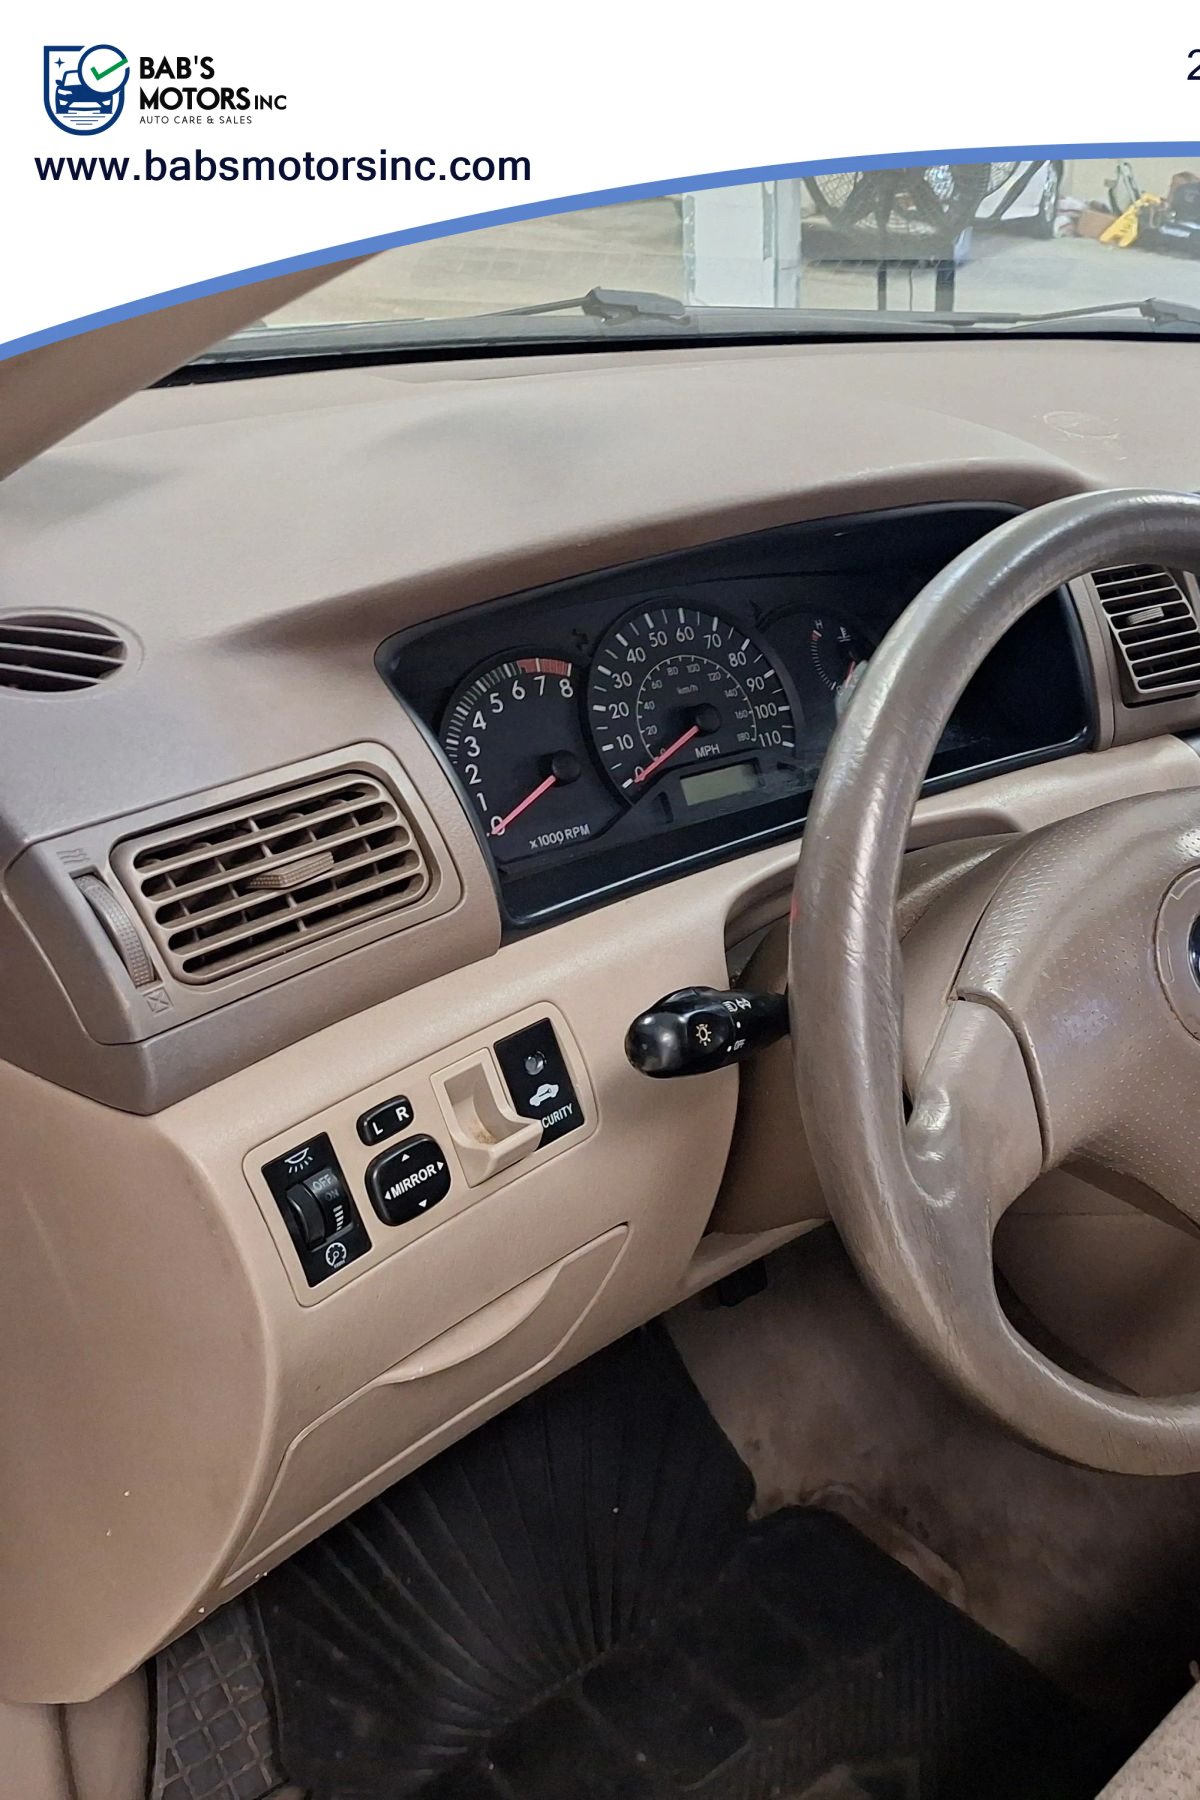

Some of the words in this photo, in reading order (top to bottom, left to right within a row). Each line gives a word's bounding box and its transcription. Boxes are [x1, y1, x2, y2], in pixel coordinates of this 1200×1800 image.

[649, 631, 667, 647] 50
[676, 626, 694, 642] 60
[703, 633, 722, 649] 70
[627, 647, 646, 663] 40
[728, 651, 747, 667] 80
[533, 675, 545, 696] 7
[559, 678, 573, 698] 8
[611, 671, 632, 689] 30
[651, 680, 663, 689] 60
[746, 676, 765, 692] 90
[512, 680, 526, 700] 6
[490, 692, 504, 713] 5
[608, 702, 629, 719] 20
[643, 700, 655, 710] 40
[754, 702, 777, 719] 100
[472, 710, 487, 730] 4
[645, 725, 657, 736] 20
[758, 730, 781, 747] 110
[464, 736, 480, 757] 3
[616, 734, 634, 750] 10
[695, 744, 720, 758] MPH
[465, 764, 482, 784] 2
[477, 793, 488, 811] 1
[490, 816, 506, 836] 0
[395, 1106, 410, 1121] R
[542, 1103, 573, 1128] CURITY
[372, 1122, 384, 1135] L
[312, 1174, 332, 1191] OFF
[390, 1164, 437, 1198] MIRROR
